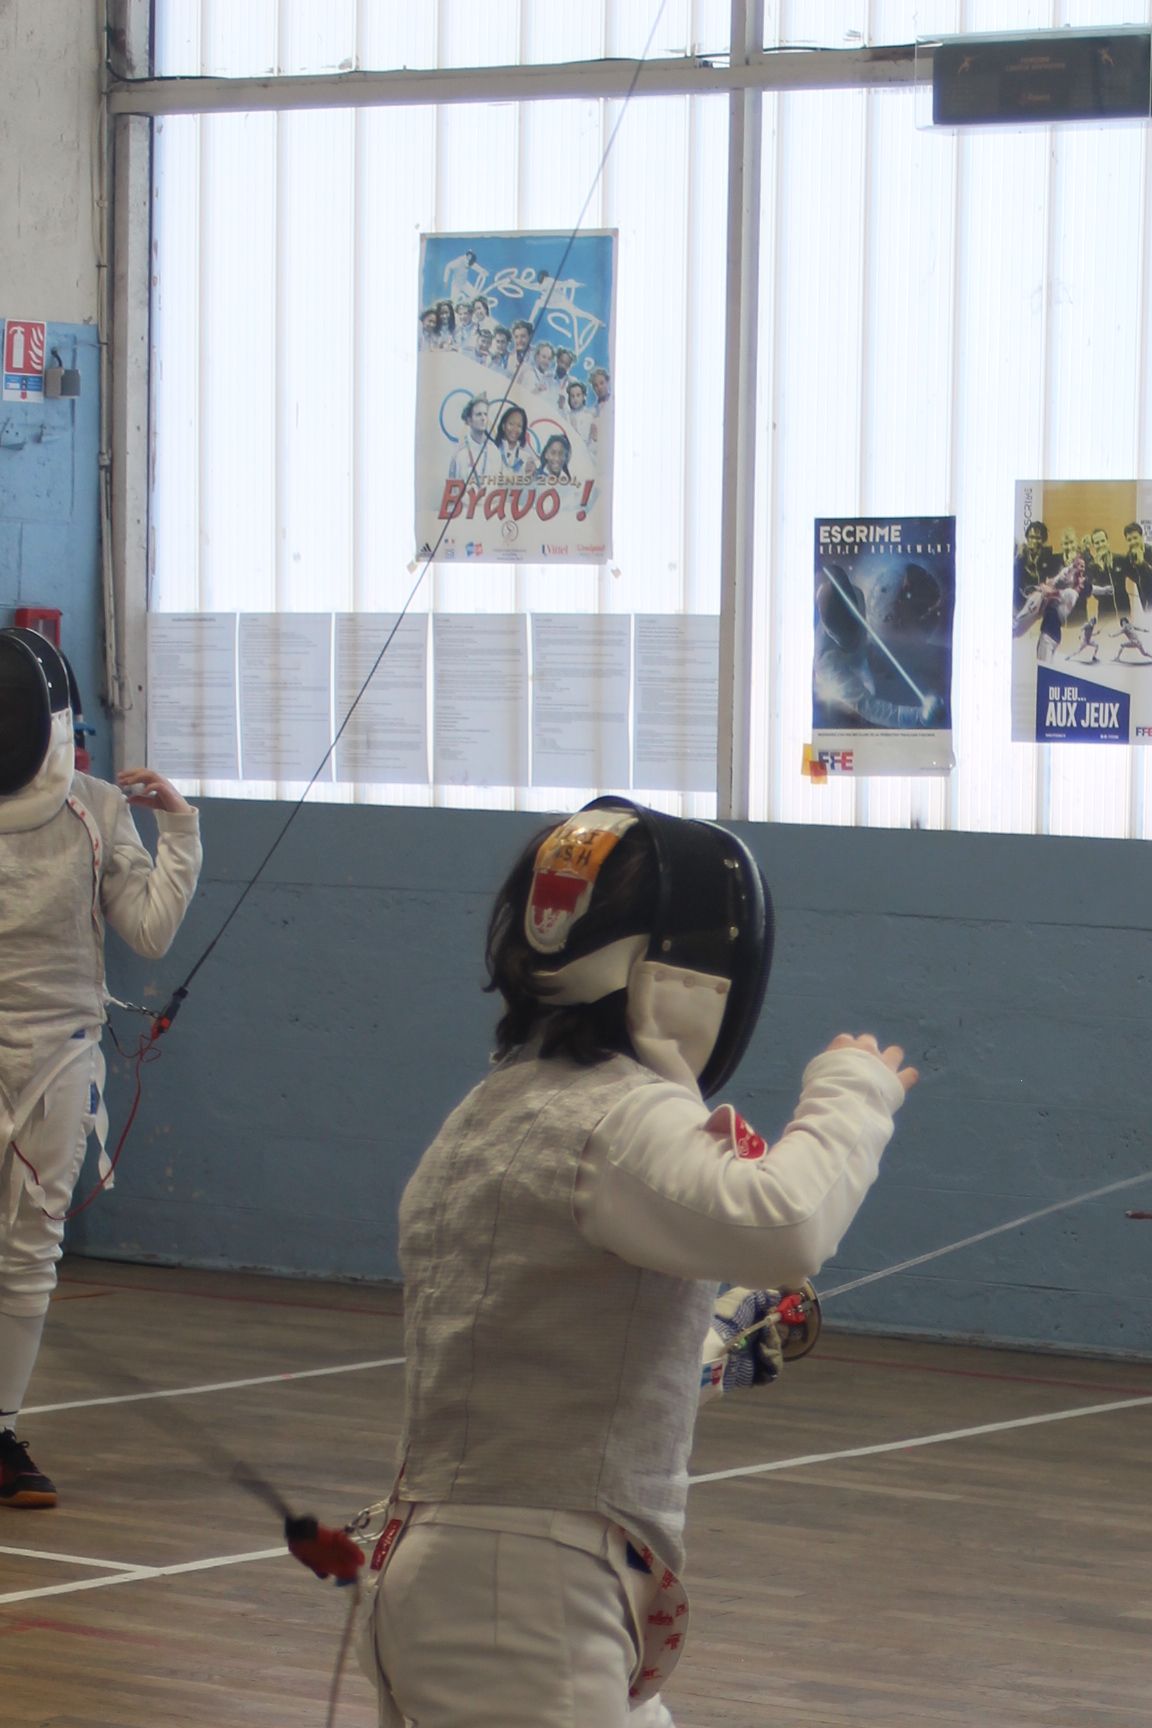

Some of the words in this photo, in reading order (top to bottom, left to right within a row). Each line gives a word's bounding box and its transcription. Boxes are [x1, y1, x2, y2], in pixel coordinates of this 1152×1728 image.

[437, 479, 561, 522] Bravo
[819, 524, 902, 543] ESCRIME
[1048, 686, 1060, 701] DU
[1045, 702, 1077, 728] AUX
[1080, 703, 1120, 729] JEUX
[817, 751, 854, 770] FFE
